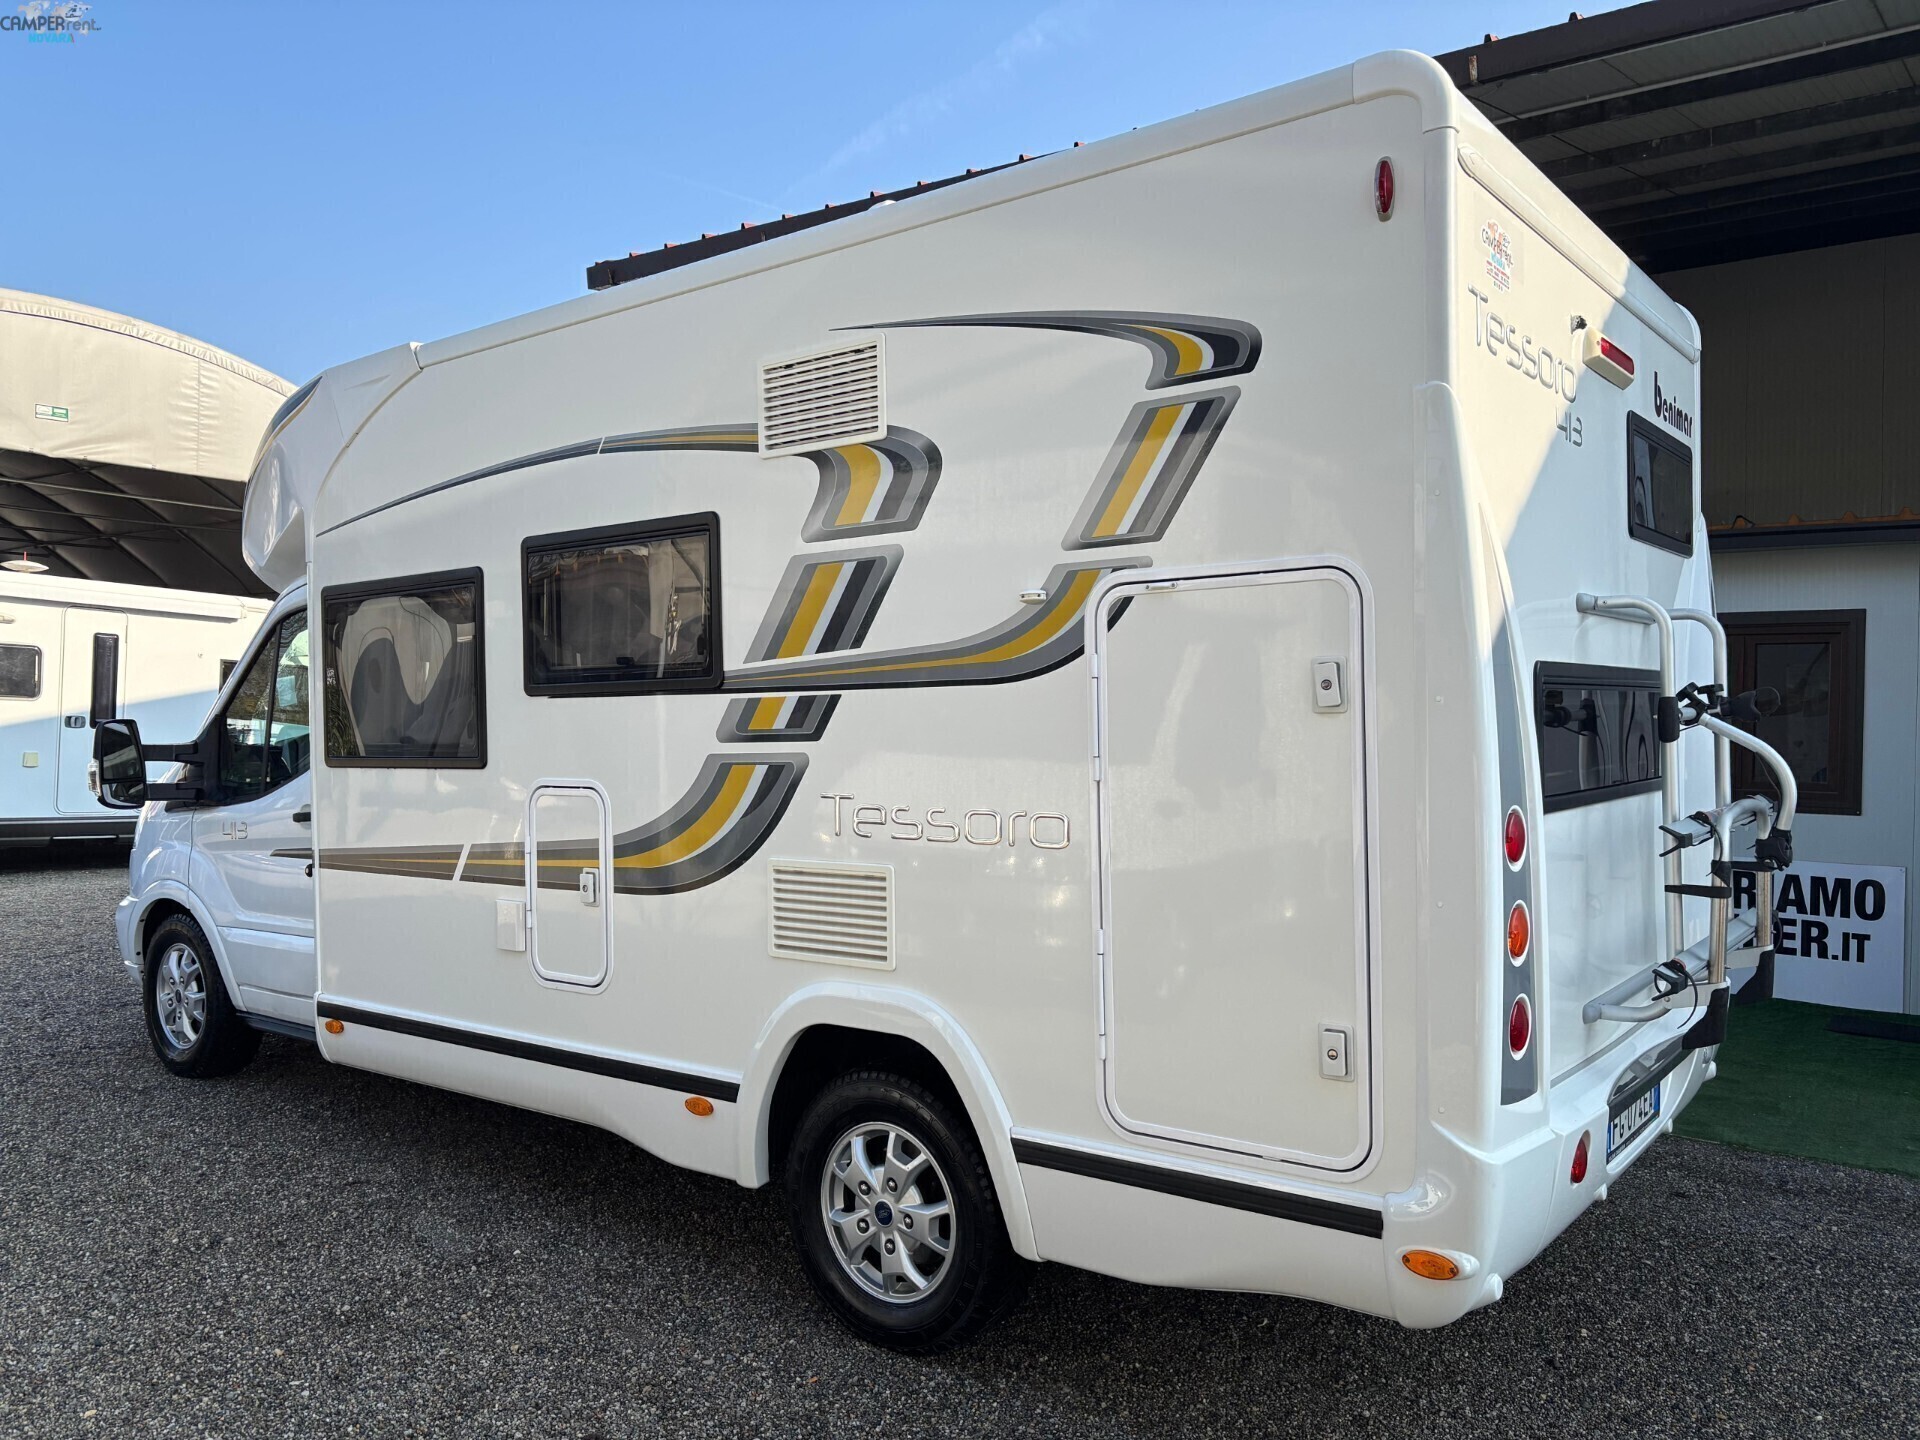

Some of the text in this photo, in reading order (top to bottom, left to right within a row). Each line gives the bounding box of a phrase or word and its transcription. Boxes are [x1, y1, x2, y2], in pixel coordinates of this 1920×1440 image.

[1468, 282, 1577, 403] Tessoro
[1555, 405, 1583, 447] 413
[1654, 370, 1693, 439] benimar
[222, 821, 249, 840] 413
[820, 792, 1071, 850] Tessoro
[1733, 870, 1886, 921] RAMO
